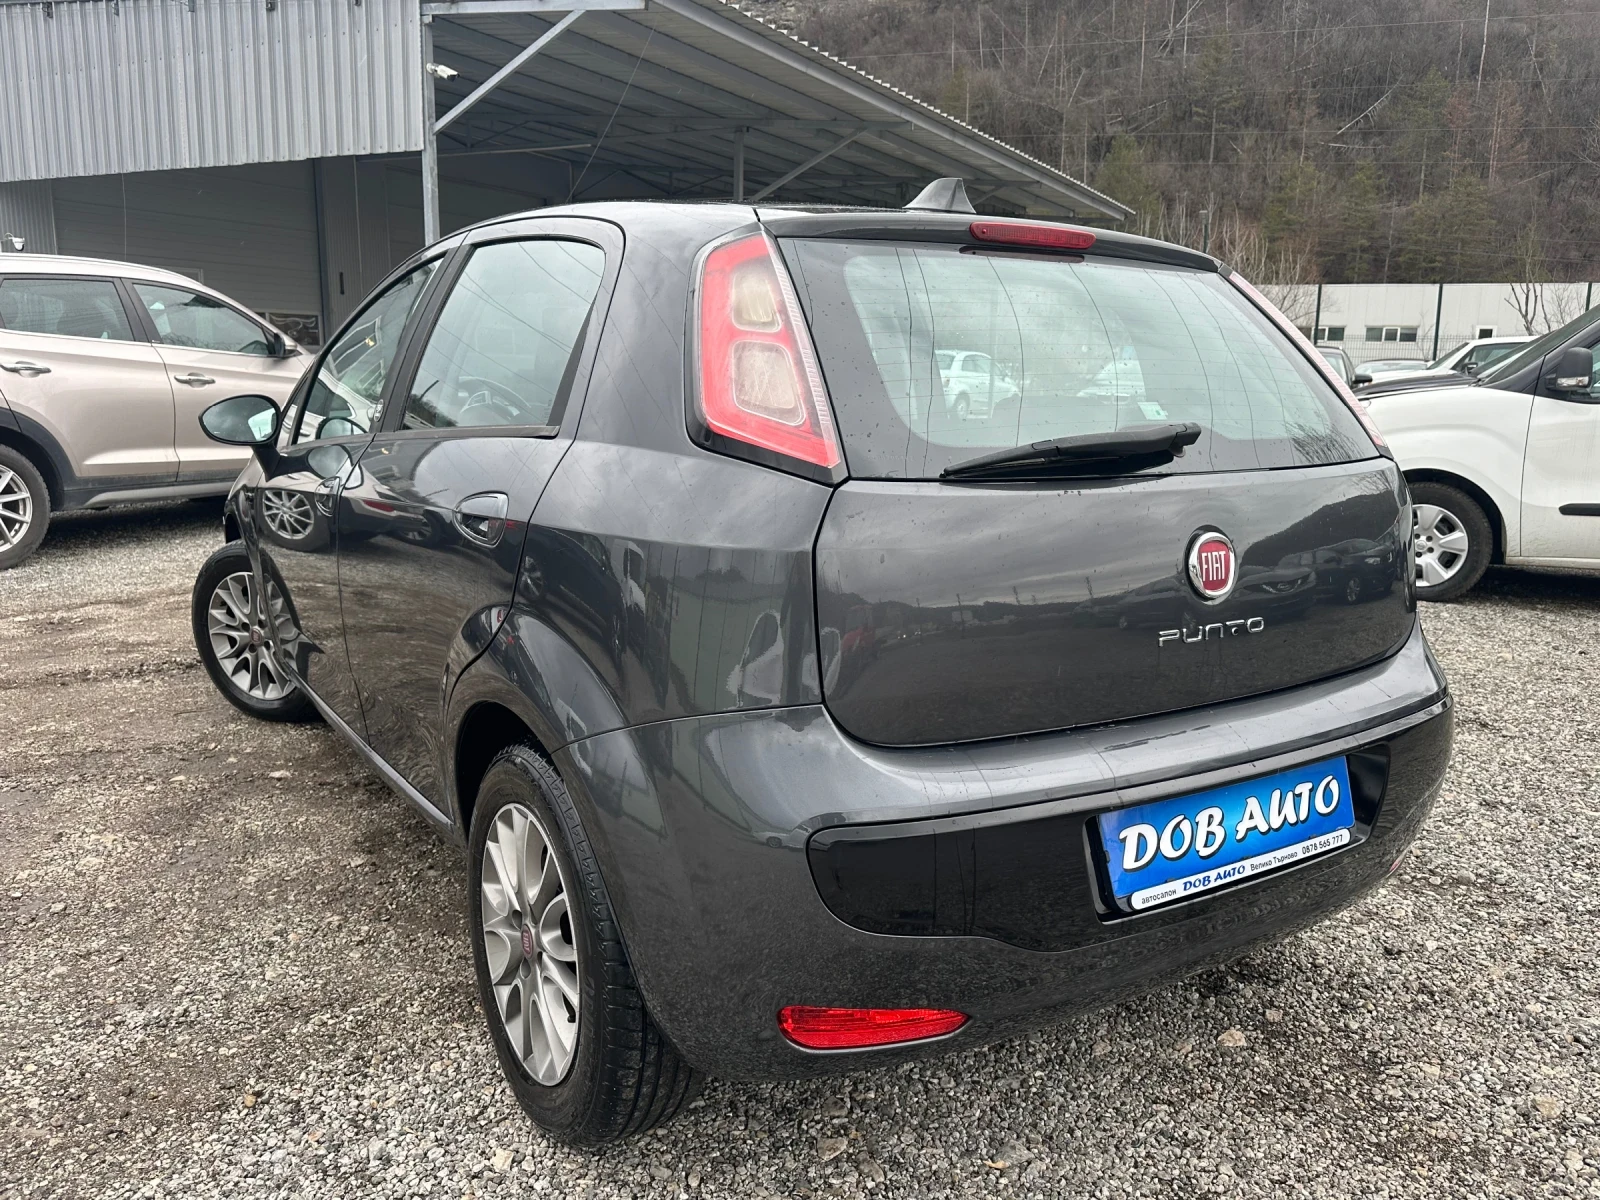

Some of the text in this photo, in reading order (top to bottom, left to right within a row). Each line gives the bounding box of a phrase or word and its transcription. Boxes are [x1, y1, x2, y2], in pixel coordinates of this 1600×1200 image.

[1201, 551, 1226, 581] FIAT
[1158, 616, 1265, 647] PUNTO
[1118, 775, 1341, 872] DOB AUTO
[1141, 834, 1344, 905] автосалон DOB AUTO Велико Търново 0878 565 777
